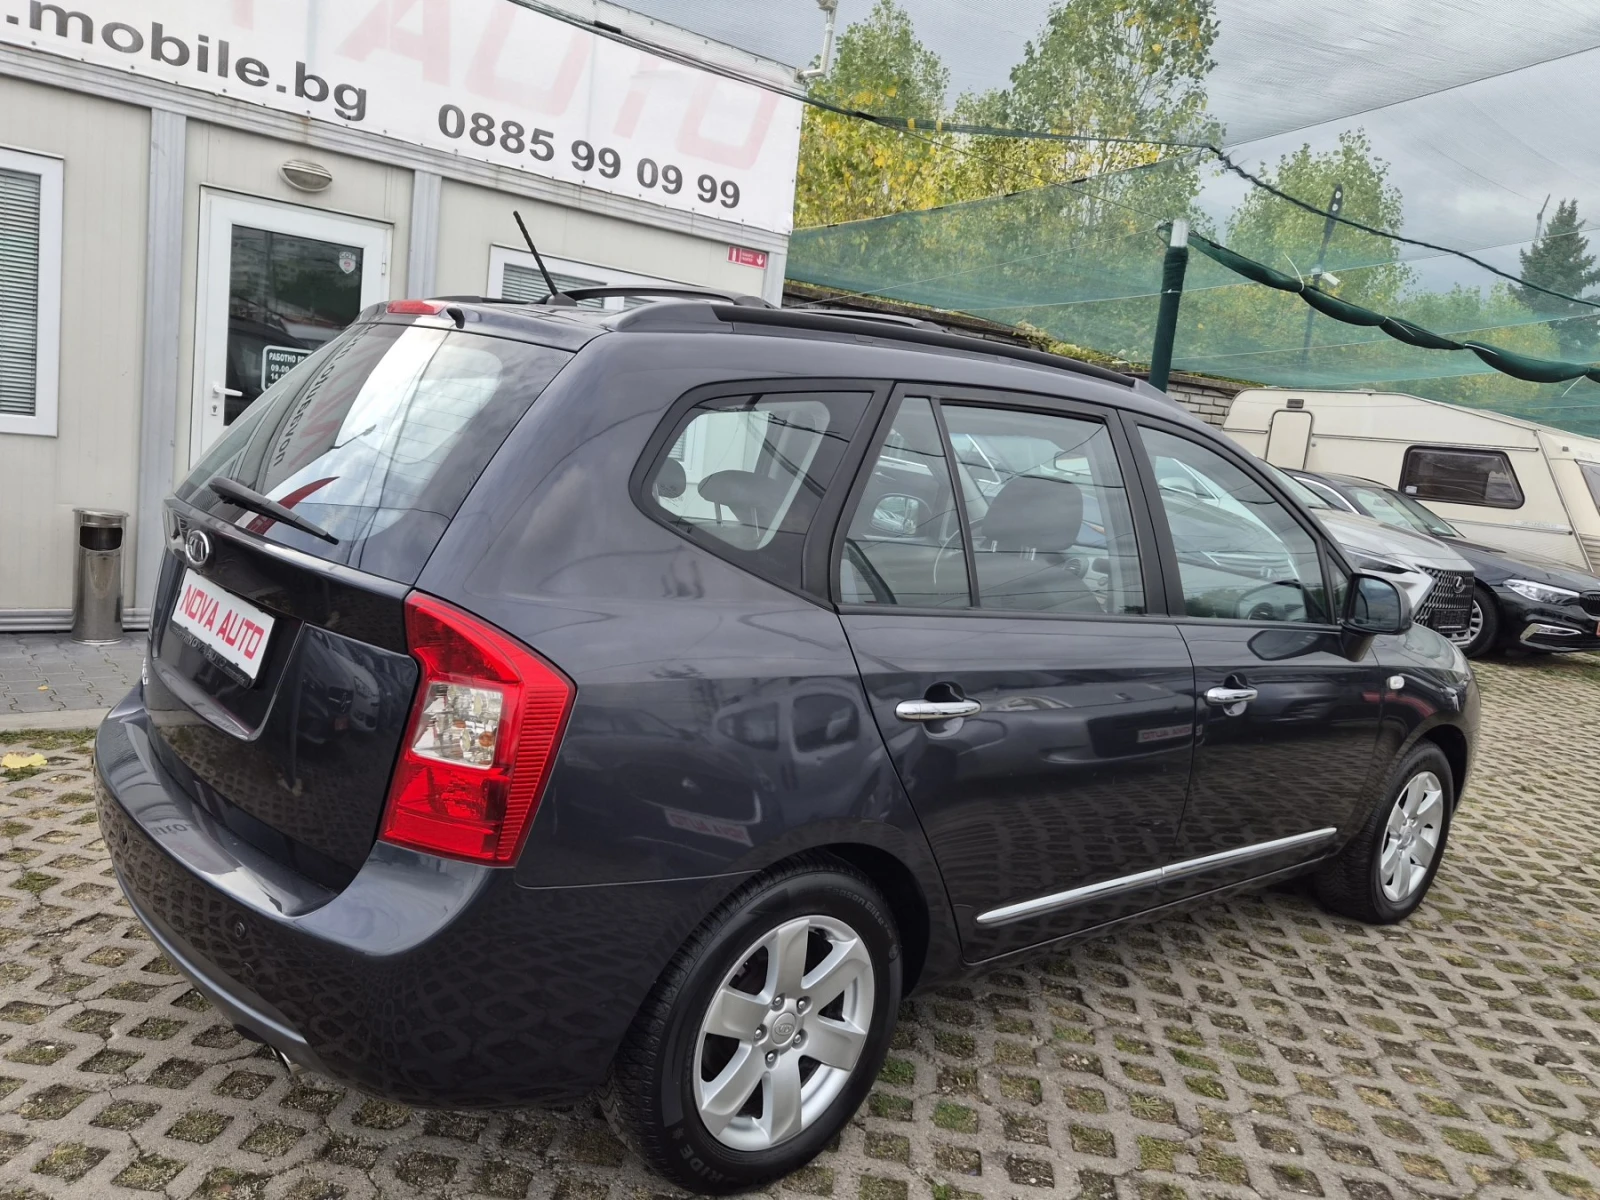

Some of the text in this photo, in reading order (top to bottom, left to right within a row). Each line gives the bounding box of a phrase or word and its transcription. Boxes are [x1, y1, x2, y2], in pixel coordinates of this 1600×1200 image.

[438, 104, 740, 208] 0885 99 09 99
[269, 352, 296, 363] РАБОТНО
[179, 584, 265, 660] NOVA AUTO
